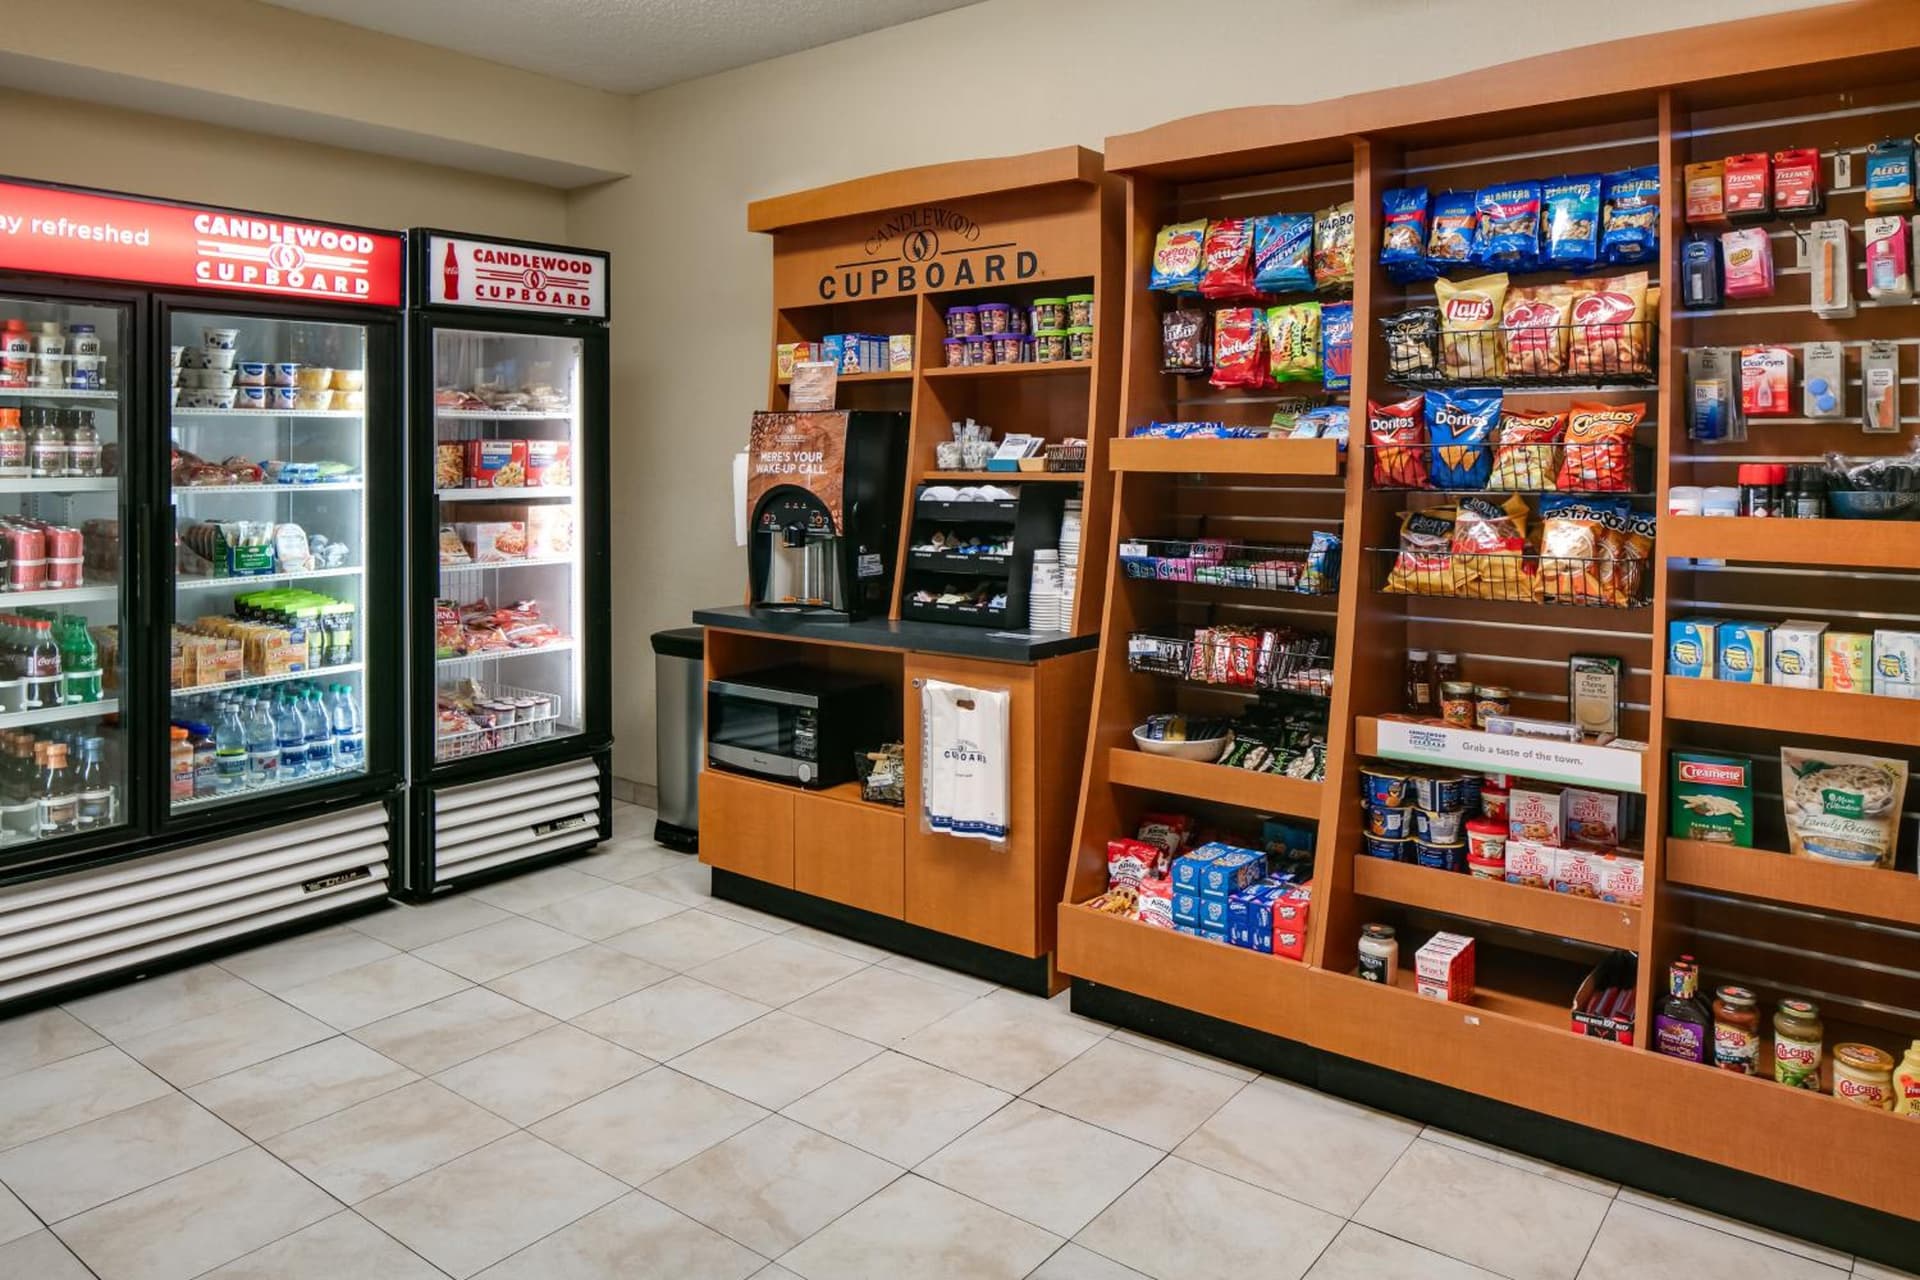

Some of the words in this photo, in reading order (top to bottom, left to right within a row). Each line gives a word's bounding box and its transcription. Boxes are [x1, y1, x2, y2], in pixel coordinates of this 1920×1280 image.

[1728, 174, 1762, 183] TYLENOL
[1776, 170, 1811, 180] TYLENOL
[31, 217, 151, 246] refreshed
[194, 214, 374, 254] CANDLEWOOD
[864, 207, 981, 256] CANDLEWOOD
[473, 248, 592, 275] CANDLEWOOD
[1265, 240, 1301, 271] CHEWY
[195, 261, 370, 295] CUPBOARD
[819, 250, 1038, 300] CUPBOARD
[475, 284, 591, 307] CUPBOARD
[1449, 299, 1493, 321] Lay's
[1766, 360, 1785, 368] eyes
[1370, 416, 1415, 431] Doritos
[1435, 411, 1489, 427] Doritos
[1573, 411, 1635, 435] Cheetos
[760, 451, 791, 462] HERE'S
[793, 451, 824, 463] YOUR
[756, 463, 797, 474] WAKE-UP
[1462, 741, 1486, 753] Grab
[1487, 745, 1494, 753] a
[1495, 746, 1520, 758] taste
[1522, 748, 1533, 759] of
[1535, 750, 1552, 761] the
[1553, 753, 1584, 766] town.
[1681, 764, 1741, 781] Creamette
[1802, 814, 1842, 832] Family
[1842, 819, 1882, 836] Recipes
